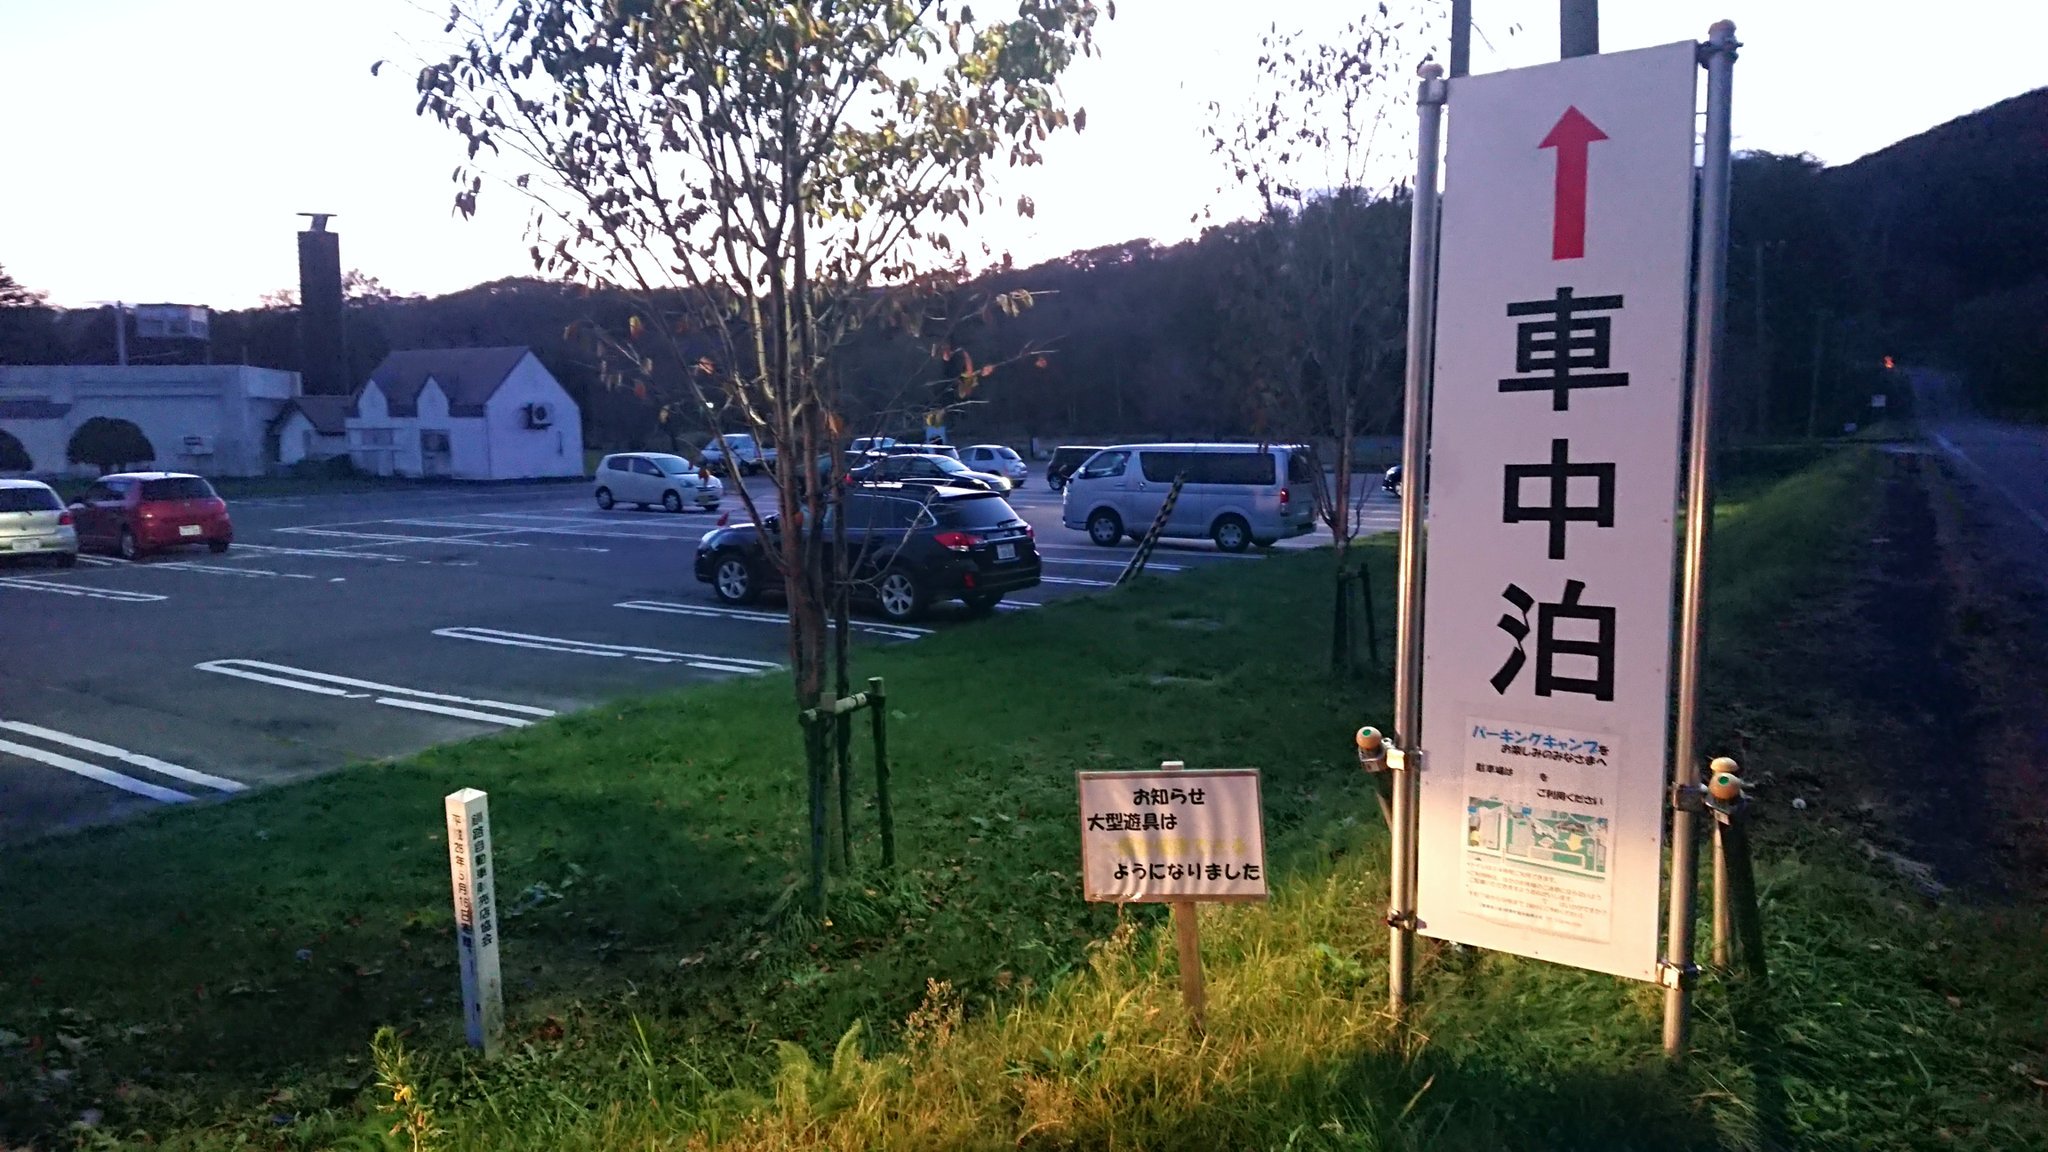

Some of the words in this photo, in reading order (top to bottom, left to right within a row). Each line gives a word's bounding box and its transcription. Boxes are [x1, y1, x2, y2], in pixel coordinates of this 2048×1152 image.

[1490, 287, 1629, 701] 車中泊
[1133, 788, 1205, 805] お知らせ
[1087, 813, 1178, 831] 大型遊具は
[1114, 863, 1260, 880] ようになりました
